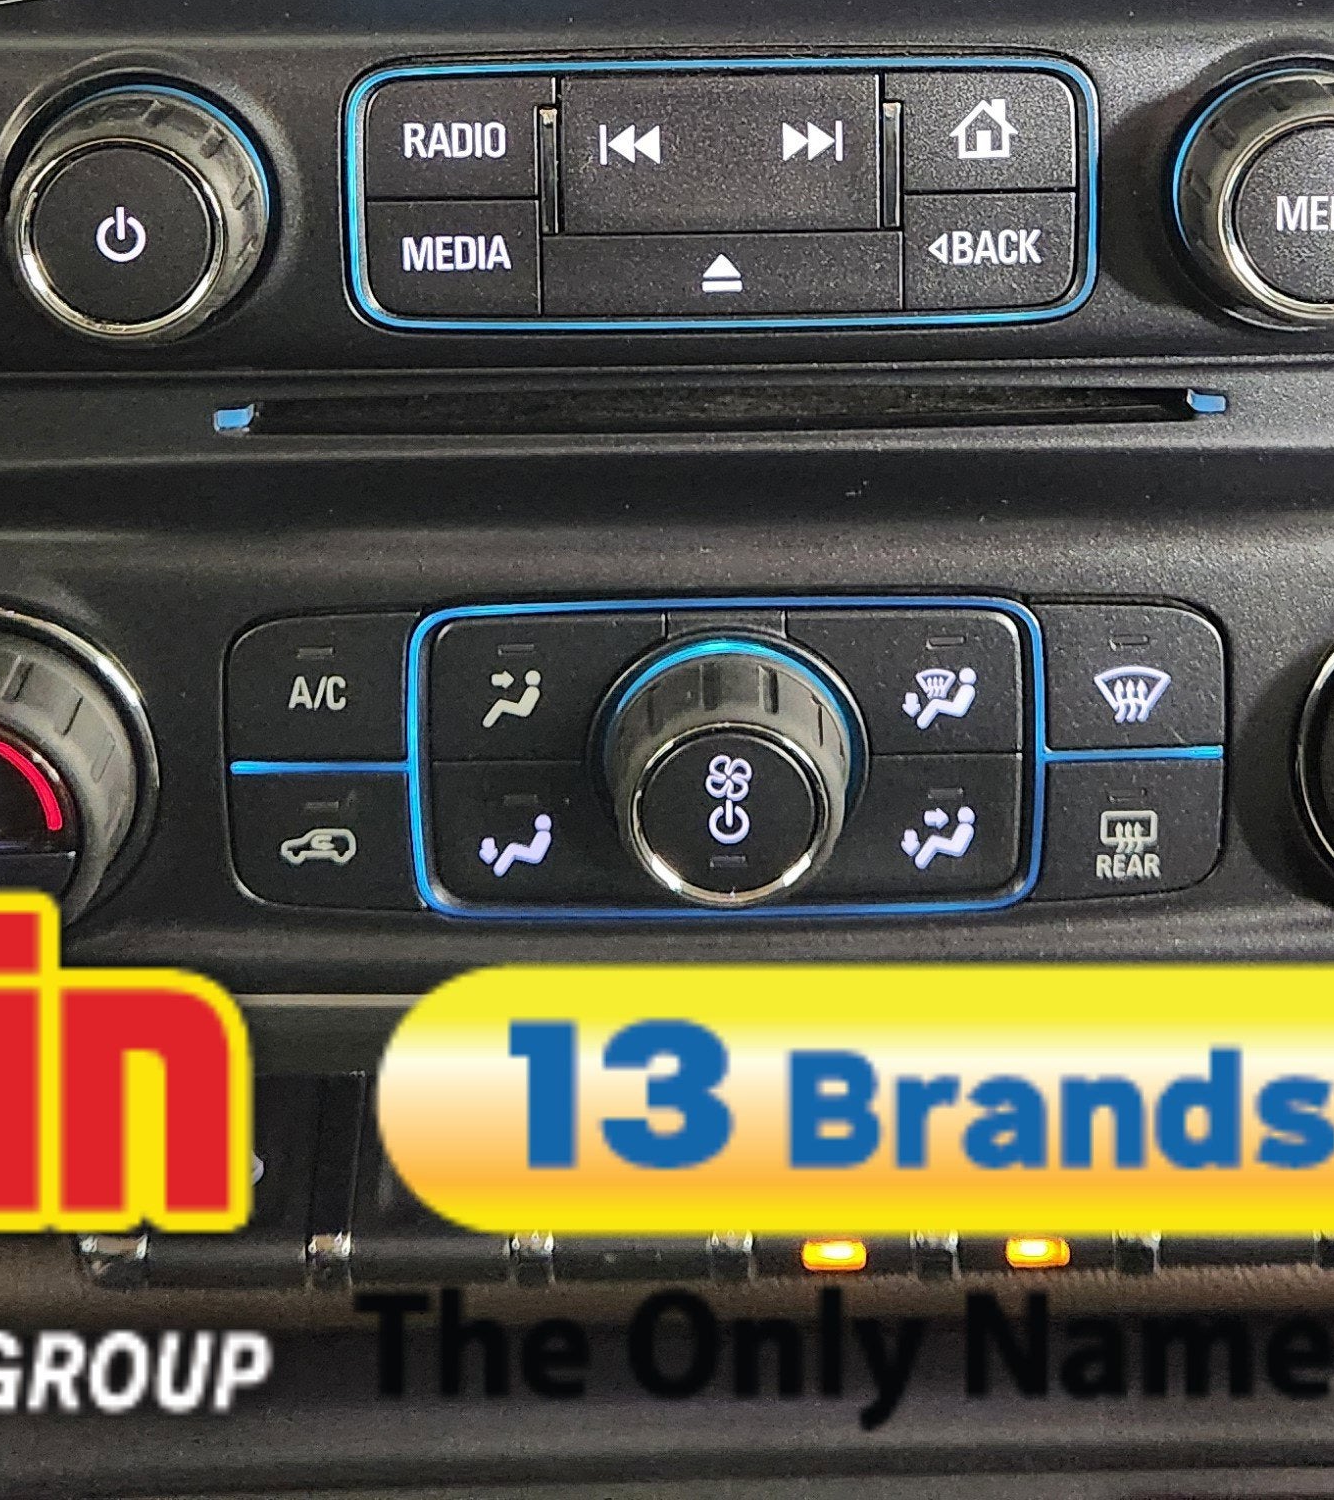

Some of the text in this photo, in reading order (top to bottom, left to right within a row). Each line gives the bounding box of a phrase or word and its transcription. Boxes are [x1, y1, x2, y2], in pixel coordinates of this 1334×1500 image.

[402, 122, 507, 160] RADIO
[402, 235, 512, 271] MEDIA
[952, 229, 1043, 265] BACK
[288, 675, 347, 711] A/C
[1095, 854, 1161, 879] REAR
